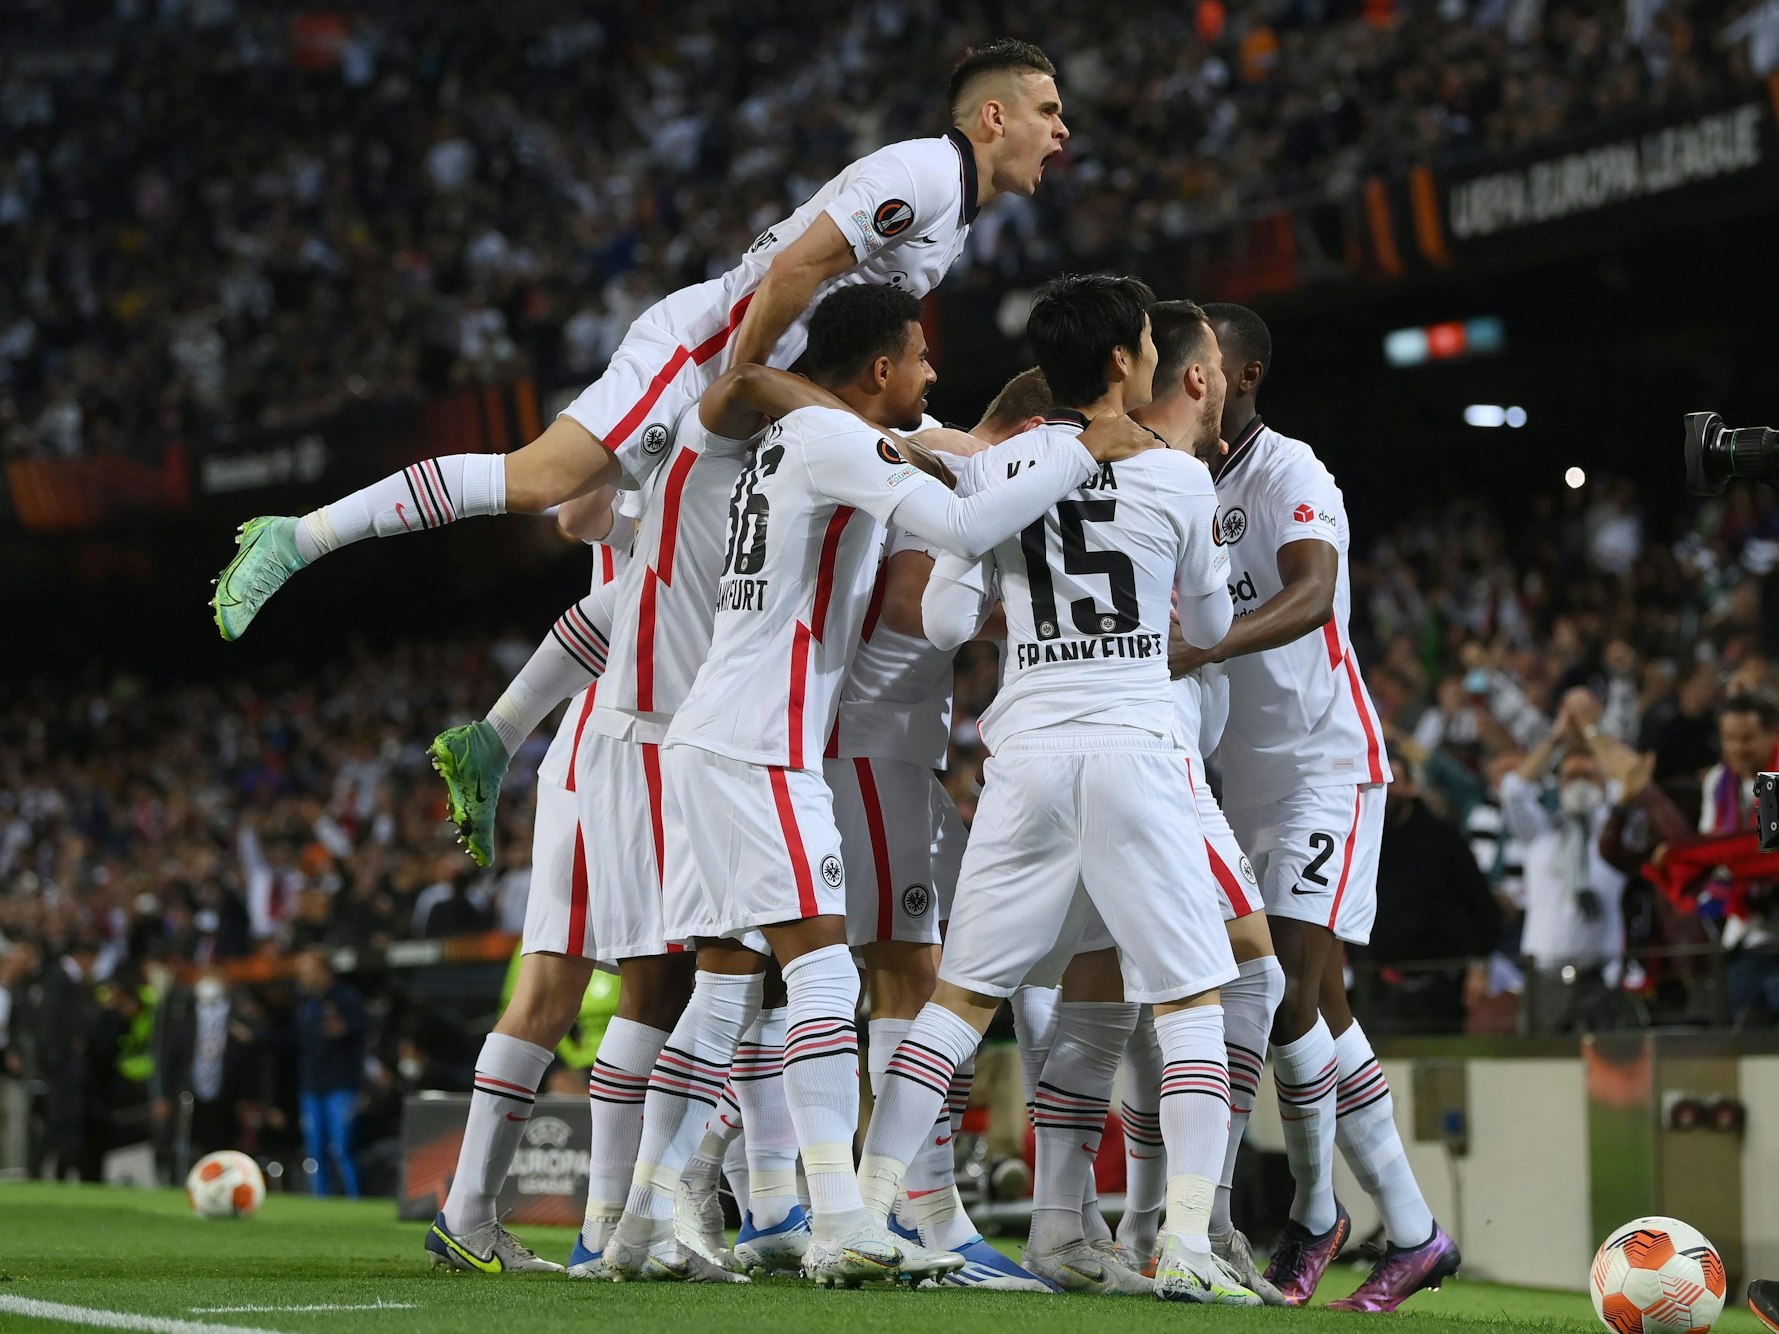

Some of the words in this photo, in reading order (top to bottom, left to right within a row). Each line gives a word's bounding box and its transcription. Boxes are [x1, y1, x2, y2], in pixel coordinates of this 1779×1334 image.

[1020, 499, 1141, 642] 15
[1017, 633, 1162, 670] FRANKFURT
[1301, 832, 1335, 887] 2
